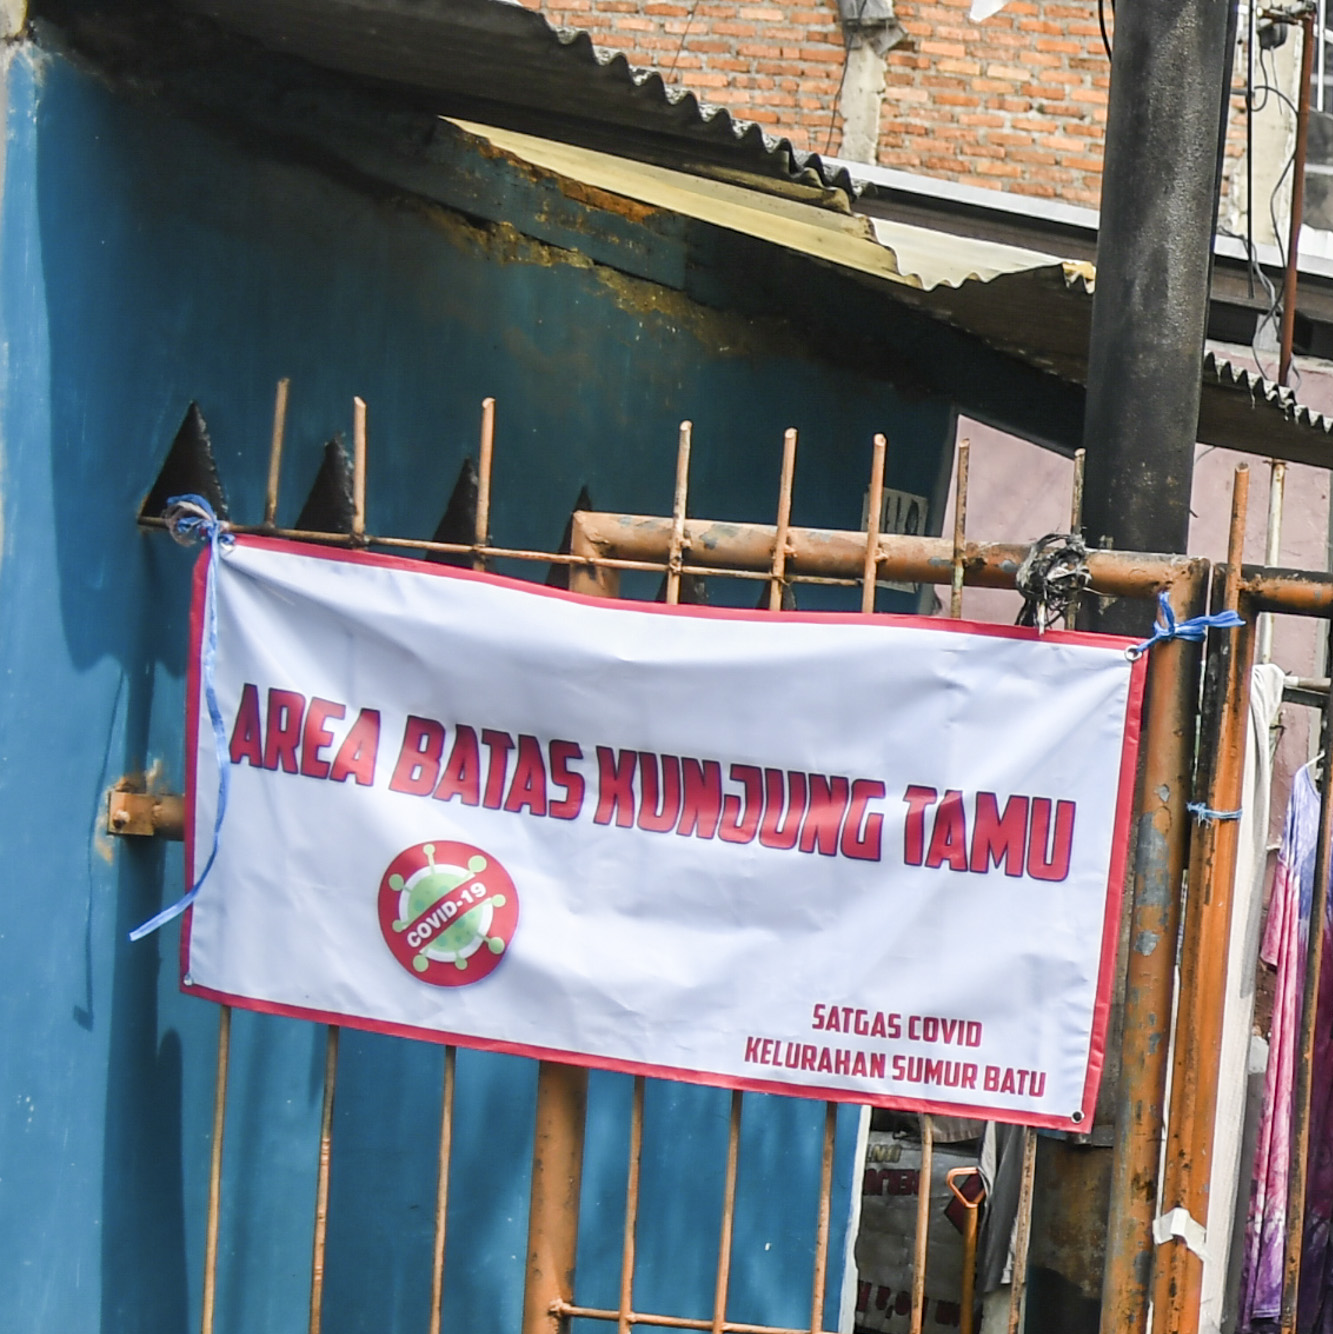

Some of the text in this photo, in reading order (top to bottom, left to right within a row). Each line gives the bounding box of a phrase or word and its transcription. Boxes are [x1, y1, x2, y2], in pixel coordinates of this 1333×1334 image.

[229, 683, 1076, 882] AREA BATAS KUNJUNG TAMU
[407, 882, 486, 947] COVID-19
[812, 1003, 982, 1047] SATGAS COVID
[745, 1036, 1046, 1097] KELURAHAN SUMUR BATU
